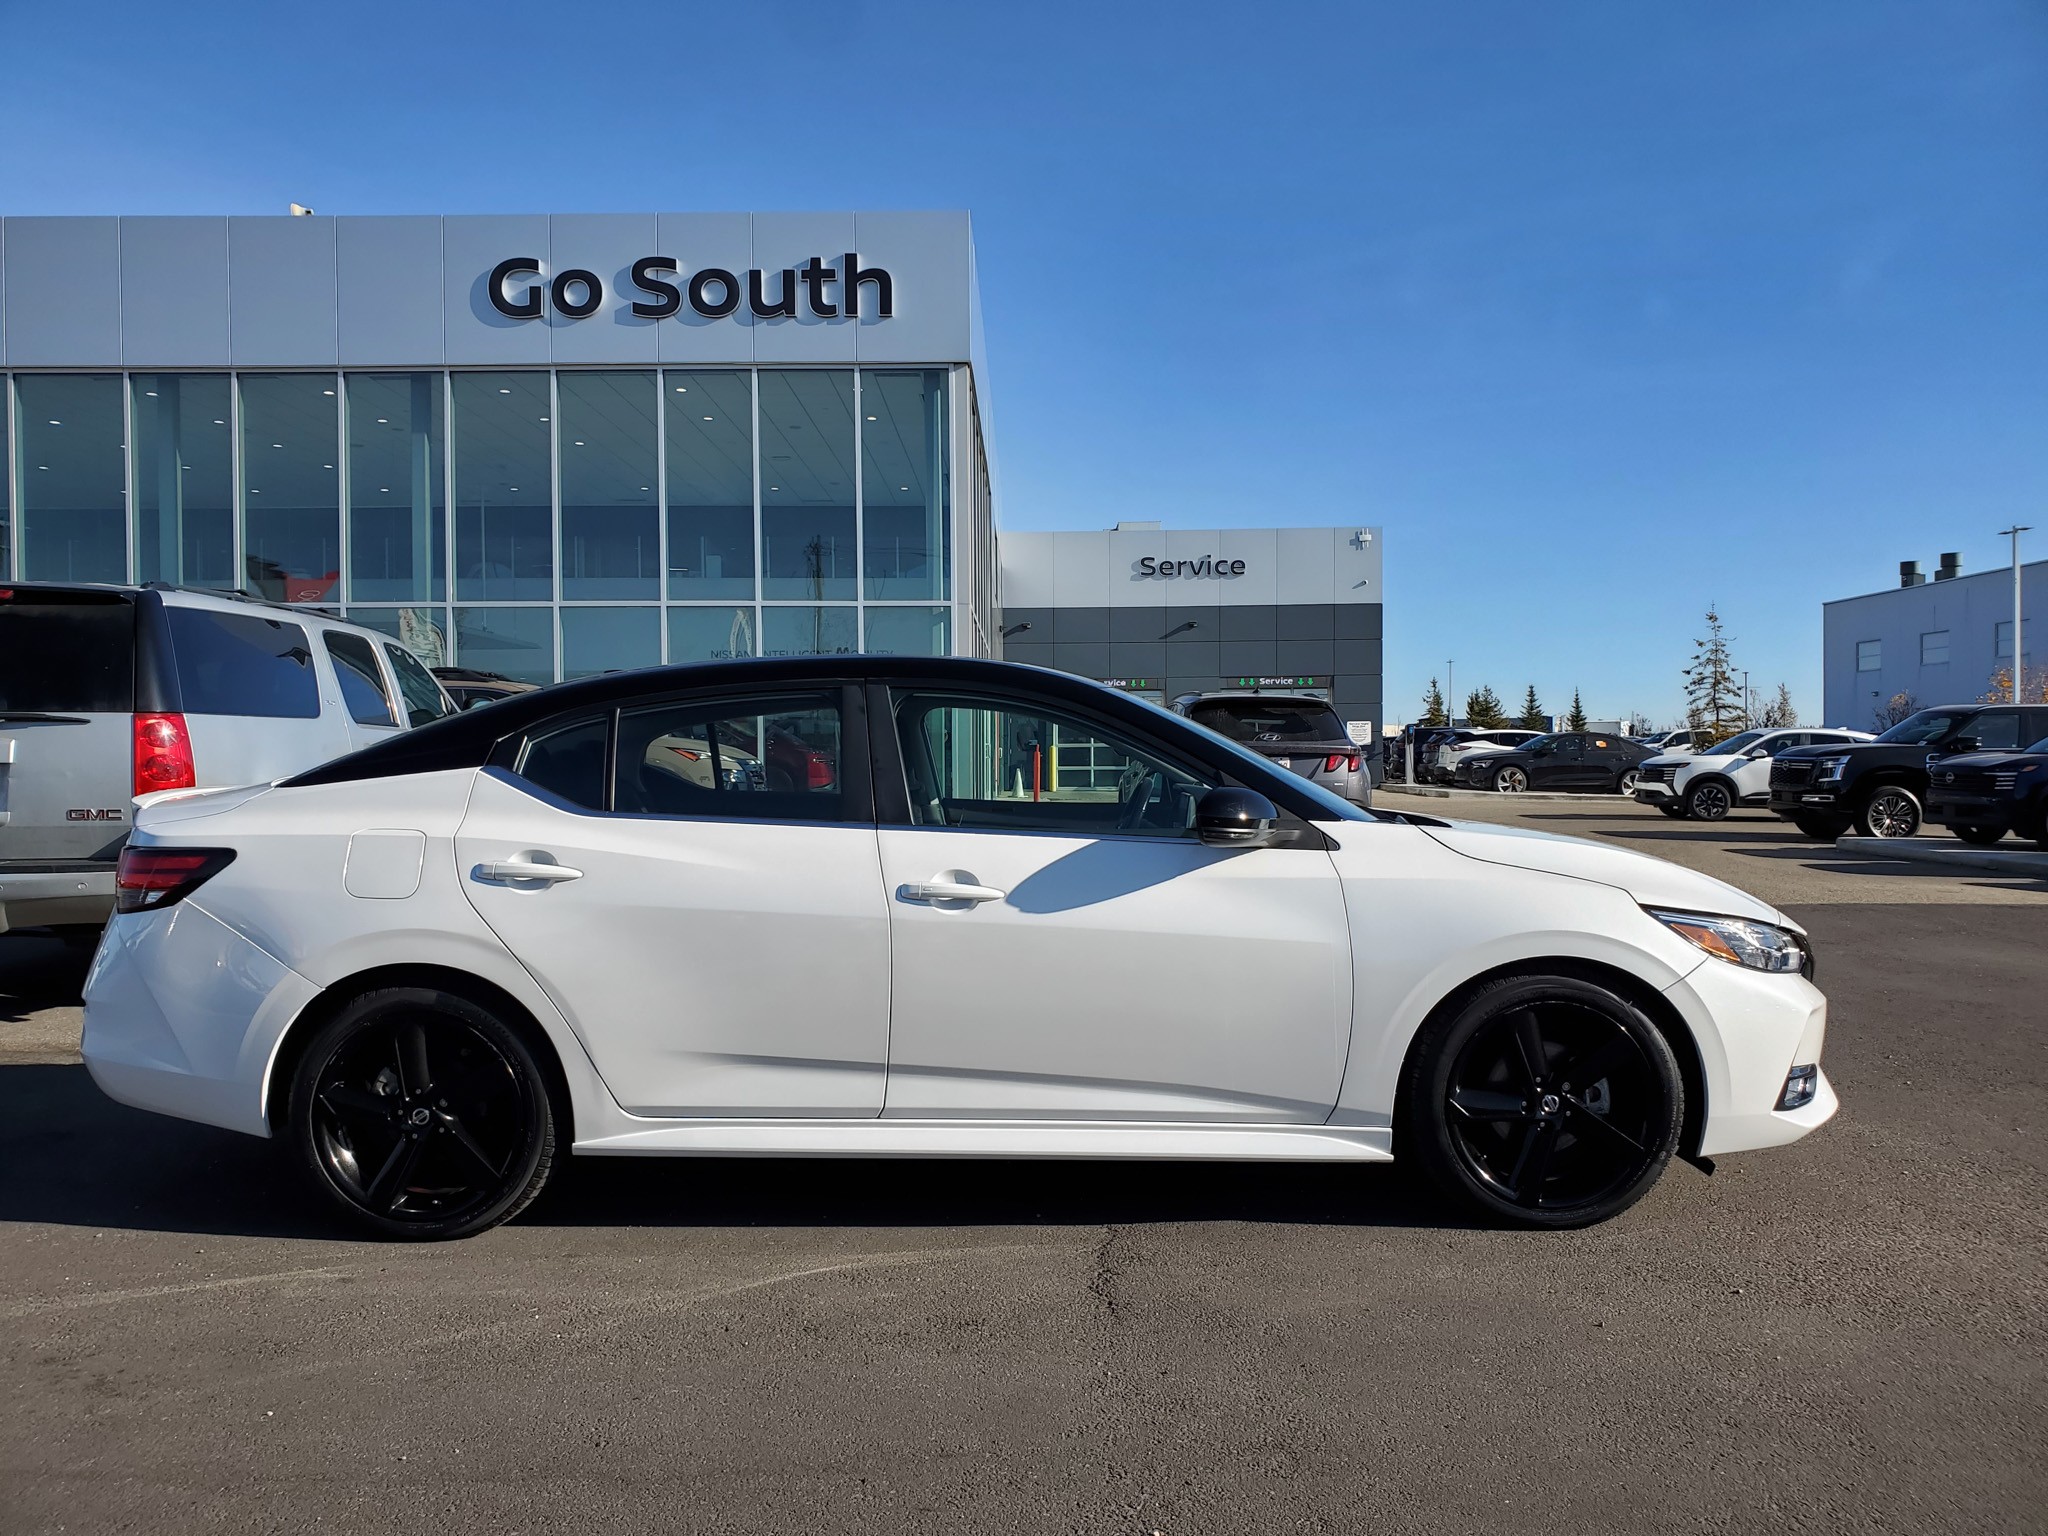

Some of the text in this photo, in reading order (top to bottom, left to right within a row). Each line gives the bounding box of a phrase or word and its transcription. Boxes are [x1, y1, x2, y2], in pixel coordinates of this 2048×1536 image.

[487, 253, 894, 318] Go South
[1140, 554, 1246, 576] Service
[1259, 677, 1294, 685] Service
[66, 809, 123, 821] GMC
